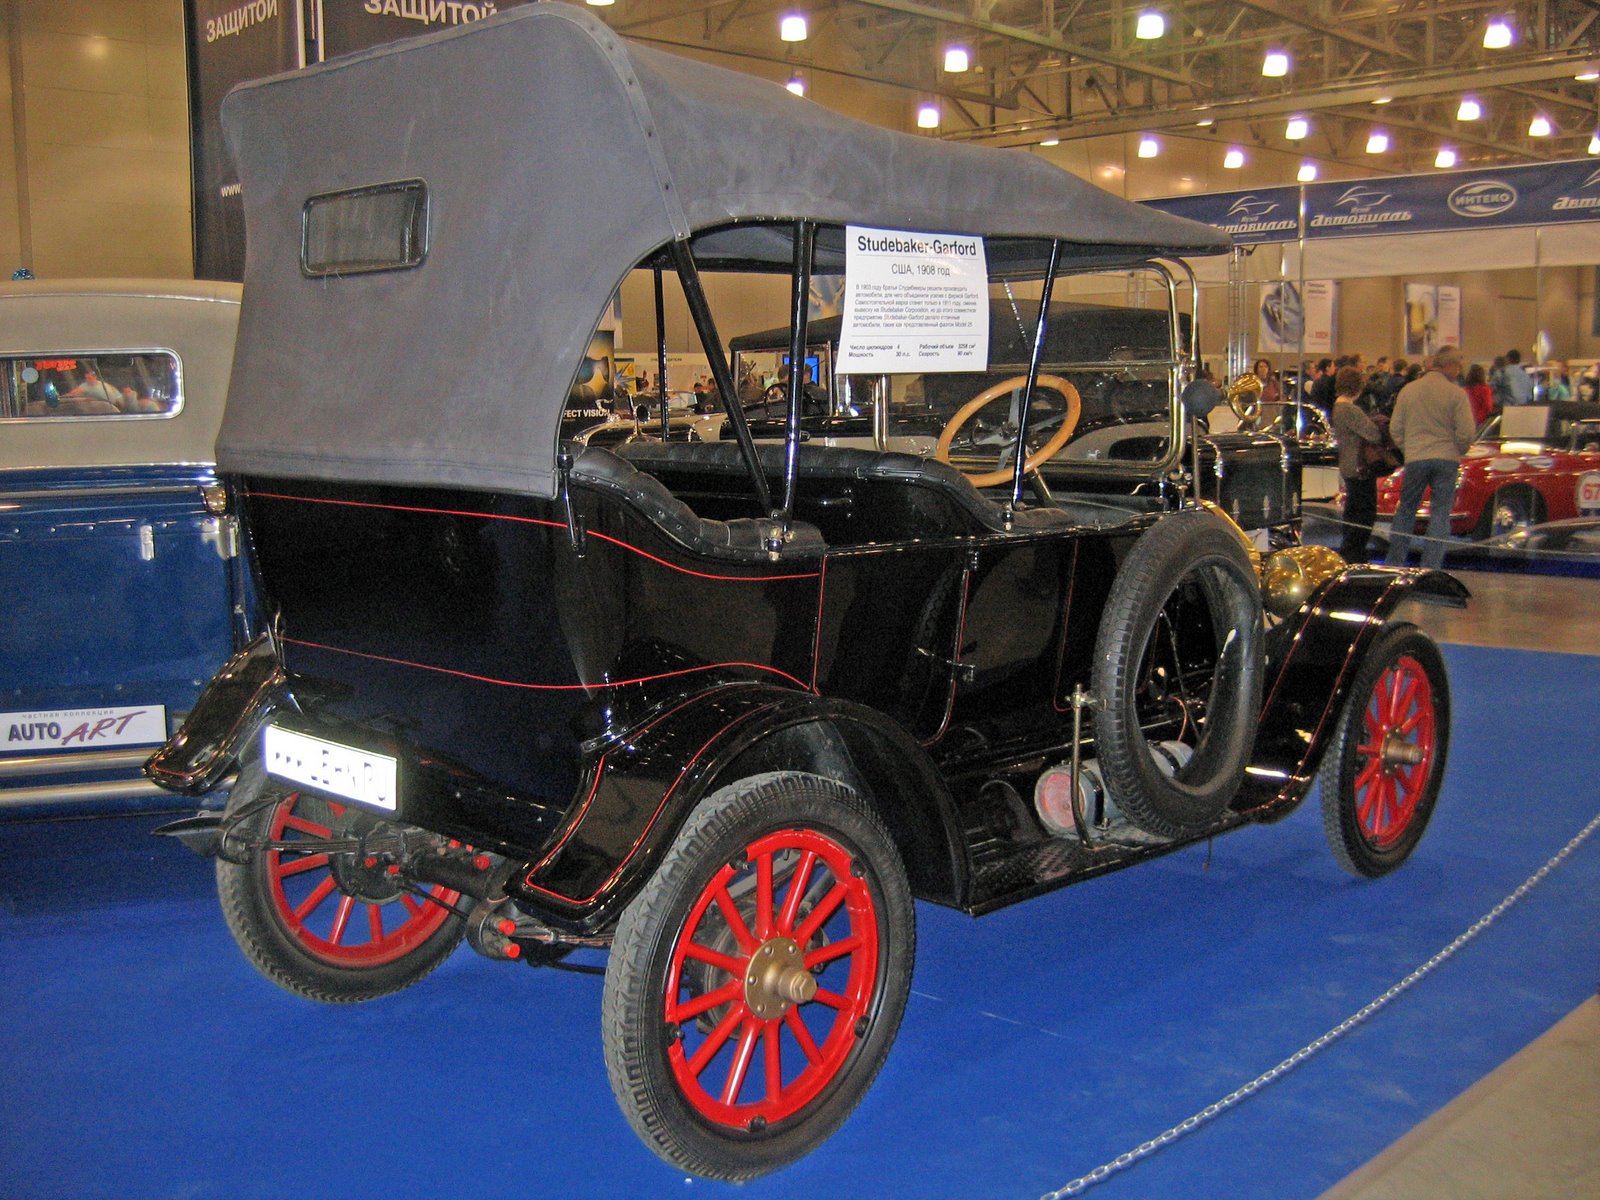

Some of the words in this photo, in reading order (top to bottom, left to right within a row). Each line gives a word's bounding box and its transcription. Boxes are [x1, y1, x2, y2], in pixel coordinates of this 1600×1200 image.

[1455, 193, 1510, 206] ИНТЕКО
[1209, 219, 1297, 234] товилль
[858, 235, 977, 256] Studebaker-Garford
[892, 264, 914, 275] США,
[917, 265, 936, 276] 1908
[938, 267, 951, 277] год
[8, 722, 62, 742] AUTO
[62, 710, 147, 746] ART
